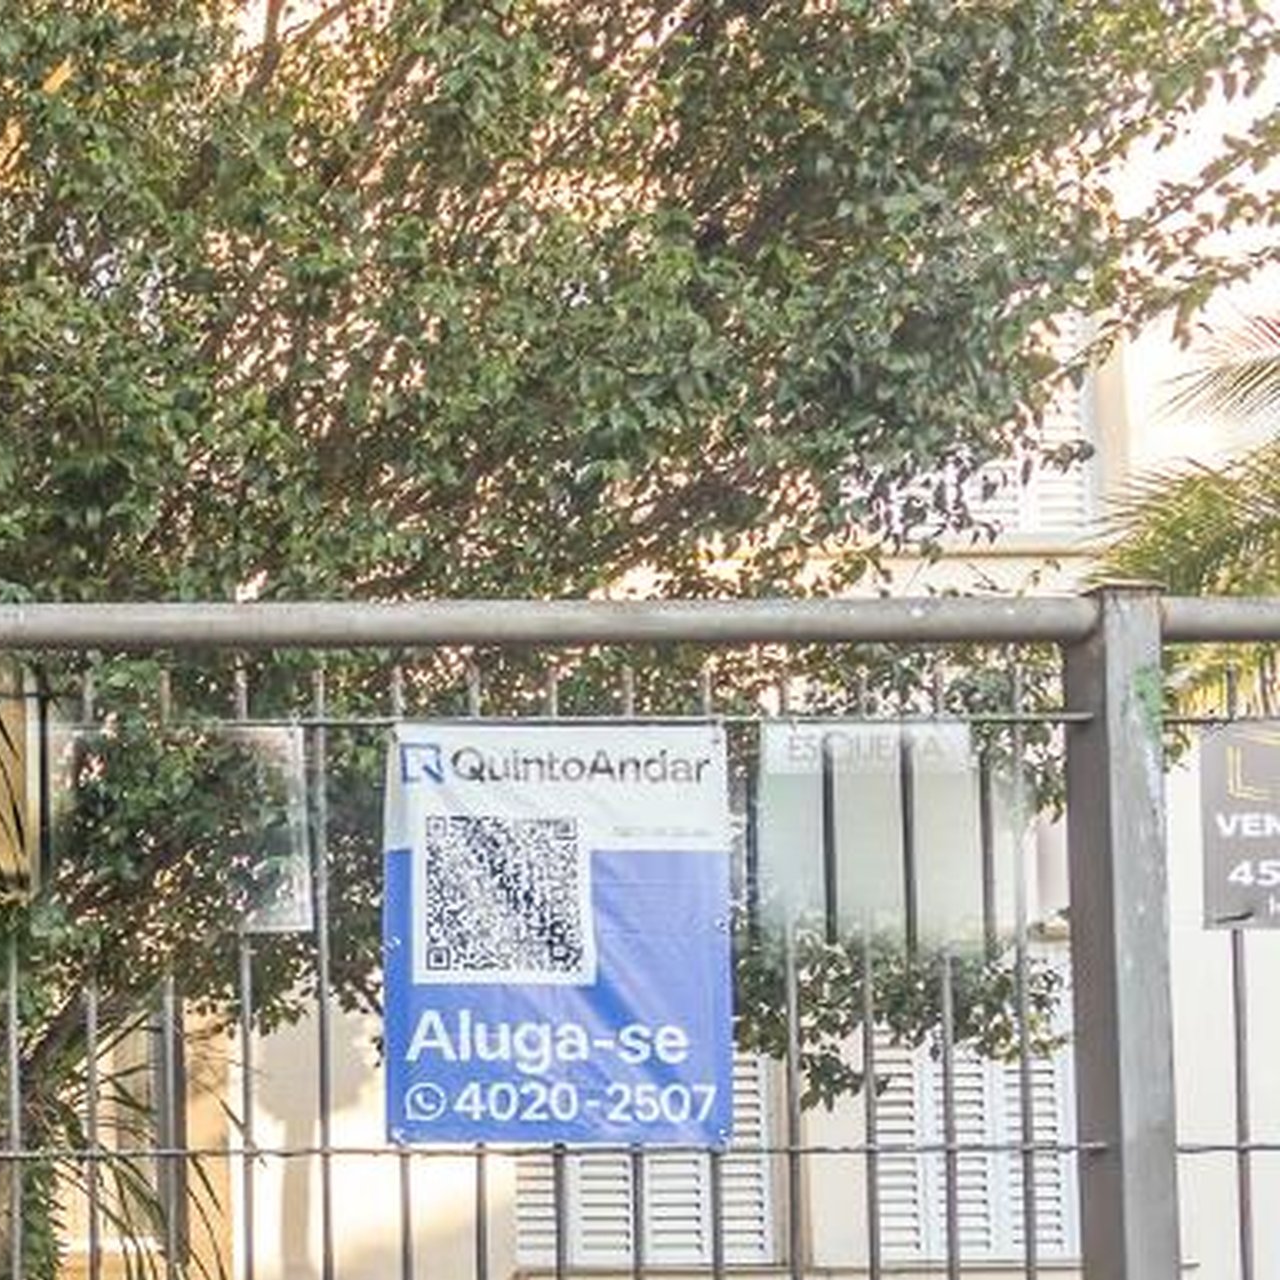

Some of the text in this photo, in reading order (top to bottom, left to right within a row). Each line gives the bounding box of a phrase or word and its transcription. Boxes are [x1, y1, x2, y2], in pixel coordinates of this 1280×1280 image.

[451, 748, 711, 782] QuintoAndar
[405, 1009, 690, 1074] Aluga-se
[453, 1083, 718, 1122] 4020-2507
